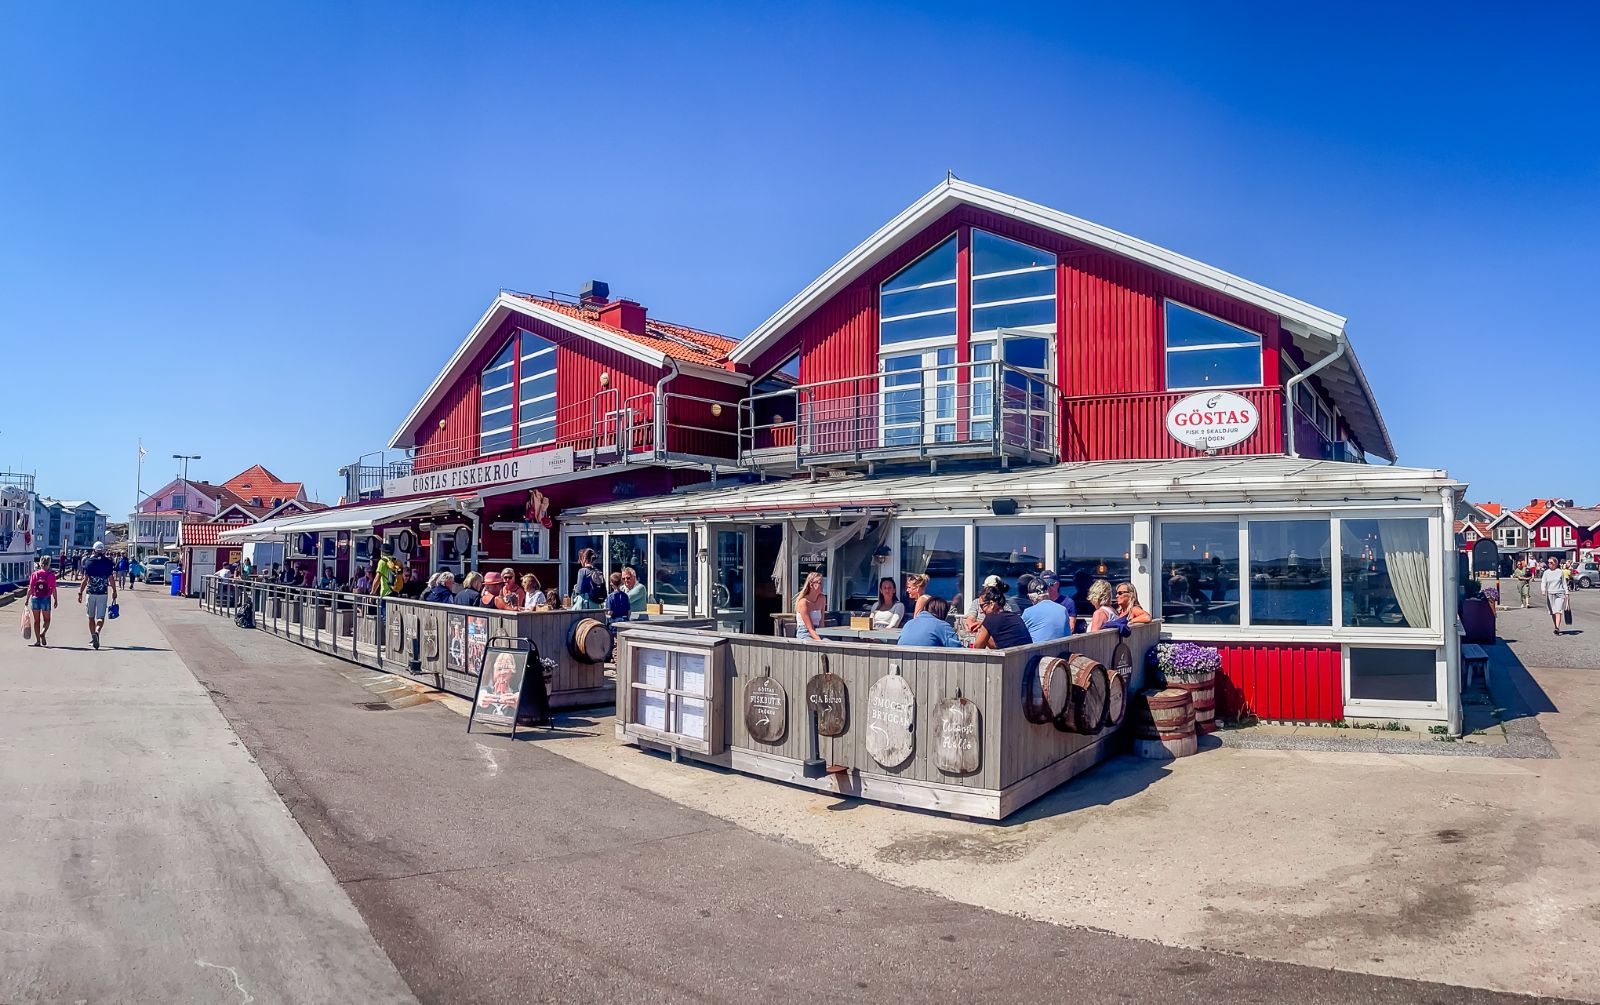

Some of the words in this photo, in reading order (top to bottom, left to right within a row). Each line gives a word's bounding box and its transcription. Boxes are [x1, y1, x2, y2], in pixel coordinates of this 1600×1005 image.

[1174, 409, 1250, 426] GÖSTAS
[413, 473, 447, 492] GÖSTAS
[452, 461, 519, 487] FISKEKROG
[750, 695, 782, 706] FISKBUTIK
